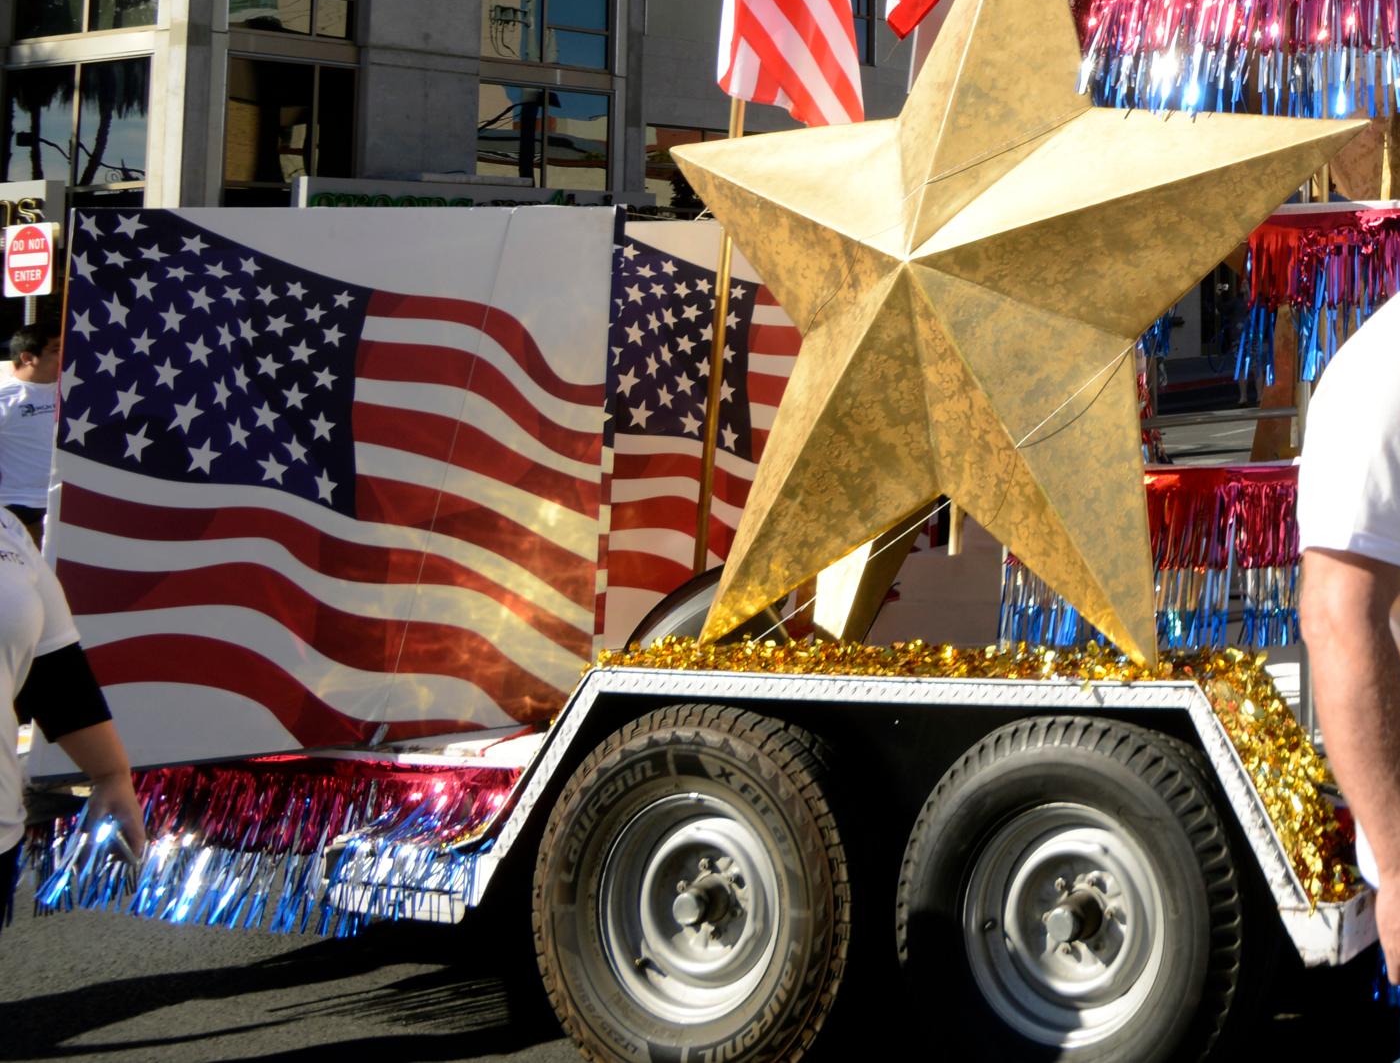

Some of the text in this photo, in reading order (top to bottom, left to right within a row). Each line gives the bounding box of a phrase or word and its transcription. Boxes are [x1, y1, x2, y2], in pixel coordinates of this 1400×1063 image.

[12, 240, 25, 252] DO
[28, 238, 46, 250] NOT
[14, 270, 42, 282] ENTER
[716, 765, 736, 786] X
